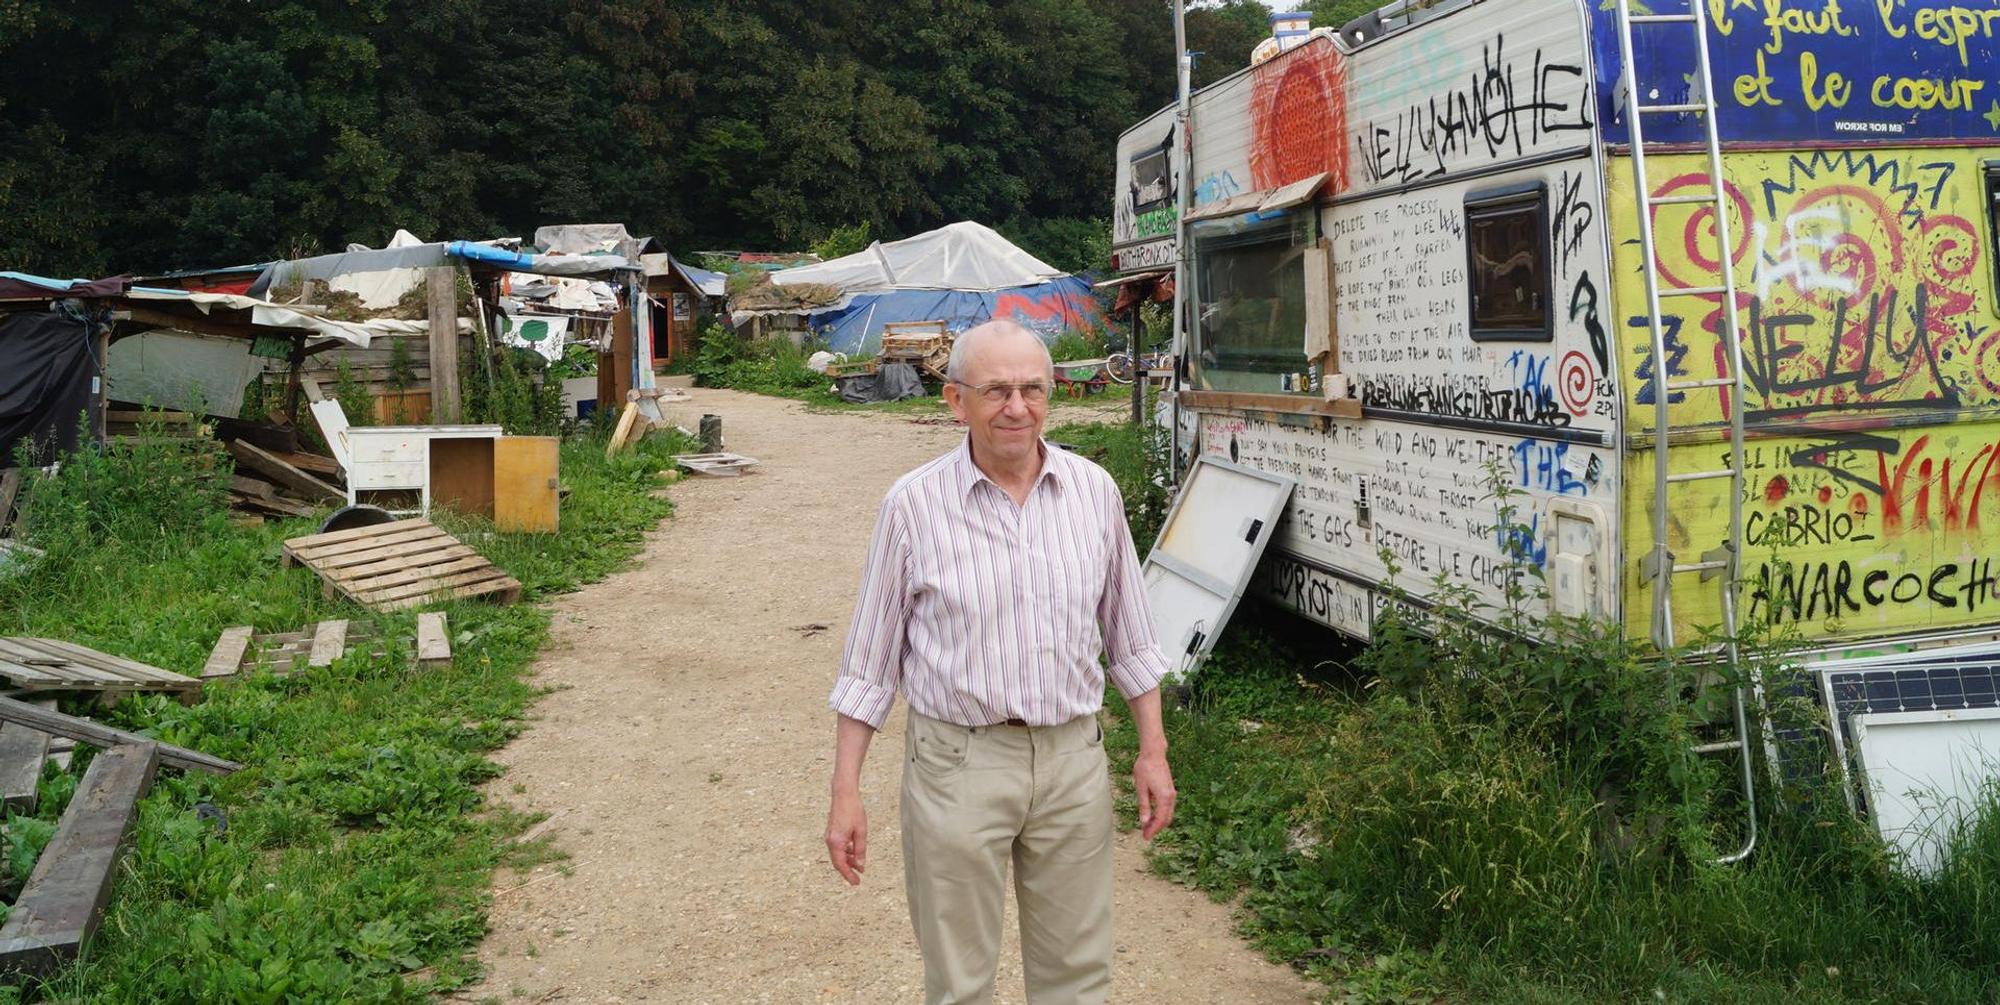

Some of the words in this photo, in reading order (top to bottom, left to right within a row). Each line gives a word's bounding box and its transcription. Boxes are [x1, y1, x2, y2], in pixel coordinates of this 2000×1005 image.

[1874, 0, 2000, 66] lespr
[1734, 48, 1783, 107] et
[1800, 51, 1852, 111] le
[1871, 73, 1984, 112] cœur
[1333, 215, 1366, 241] DELETE
[1374, 209, 1390, 225] THE
[1414, 219, 1436, 237] LIFE
[1441, 269, 1464, 287] LEGS
[1411, 432, 1437, 462] AND
[1722, 447, 1766, 469] FLL
[1298, 508, 1316, 540] THE
[1324, 515, 1353, 548] GAS
